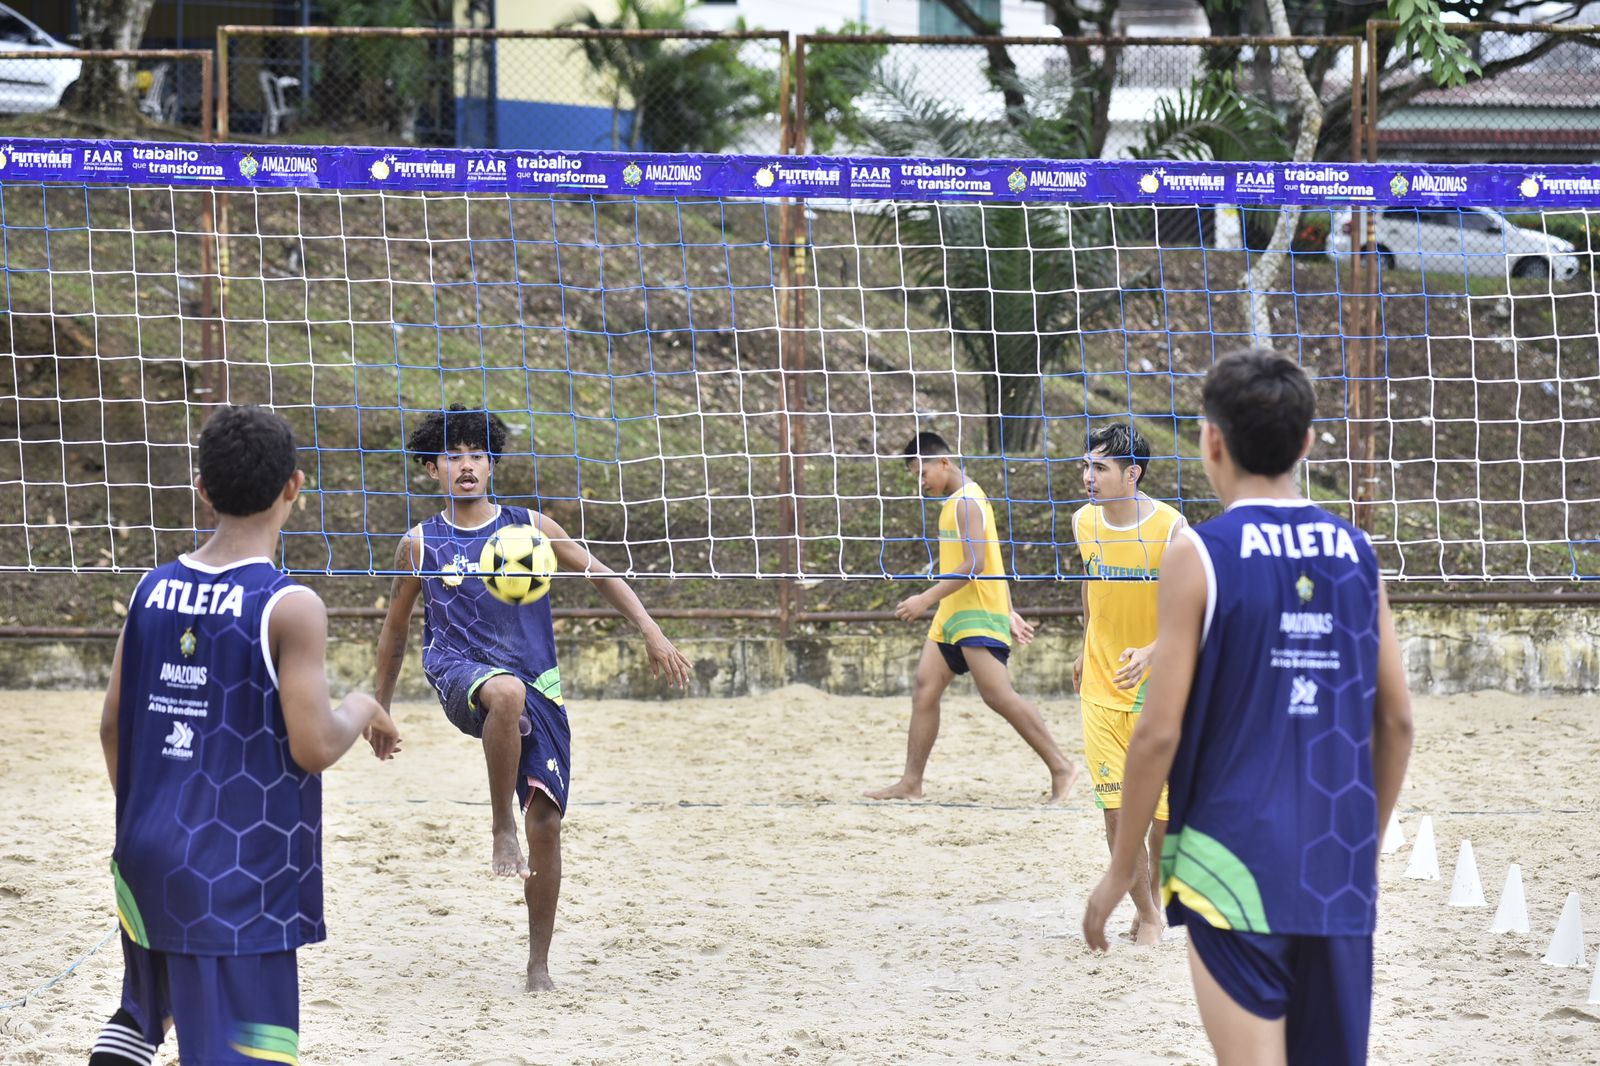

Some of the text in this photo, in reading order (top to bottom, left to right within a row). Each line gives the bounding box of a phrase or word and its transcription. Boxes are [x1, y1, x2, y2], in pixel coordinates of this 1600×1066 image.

[11, 150, 72, 164] FUTEVÔLEI
[84, 150, 123, 163] FAAR
[133, 147, 199, 161] trabalho
[149, 162, 223, 176] transforma
[261, 156, 318, 173] AMAZONAS
[394, 160, 455, 174] FUTEVÔLEI
[467, 160, 507, 173] FAAR
[516, 155, 582, 169] trabalho
[533, 170, 606, 183] transforma
[645, 164, 702, 181] AMAZONAS
[779, 167, 840, 181] FUTEVÔLEI
[851, 167, 891, 180] FAAR
[901, 163, 967, 176] trabalho
[1284, 168, 1349, 182] trabalho
[917, 177, 991, 190] transforma
[1030, 171, 1087, 187] AMAZONAS
[1164, 172, 1225, 187] FUTEVÔLEI
[1236, 172, 1275, 185] FAAR
[1411, 175, 1468, 192] AMAZONAS
[1300, 183, 1374, 196] transforma
[1240, 522, 1360, 564] ATLETA
[144, 579, 244, 617] ATLETA
